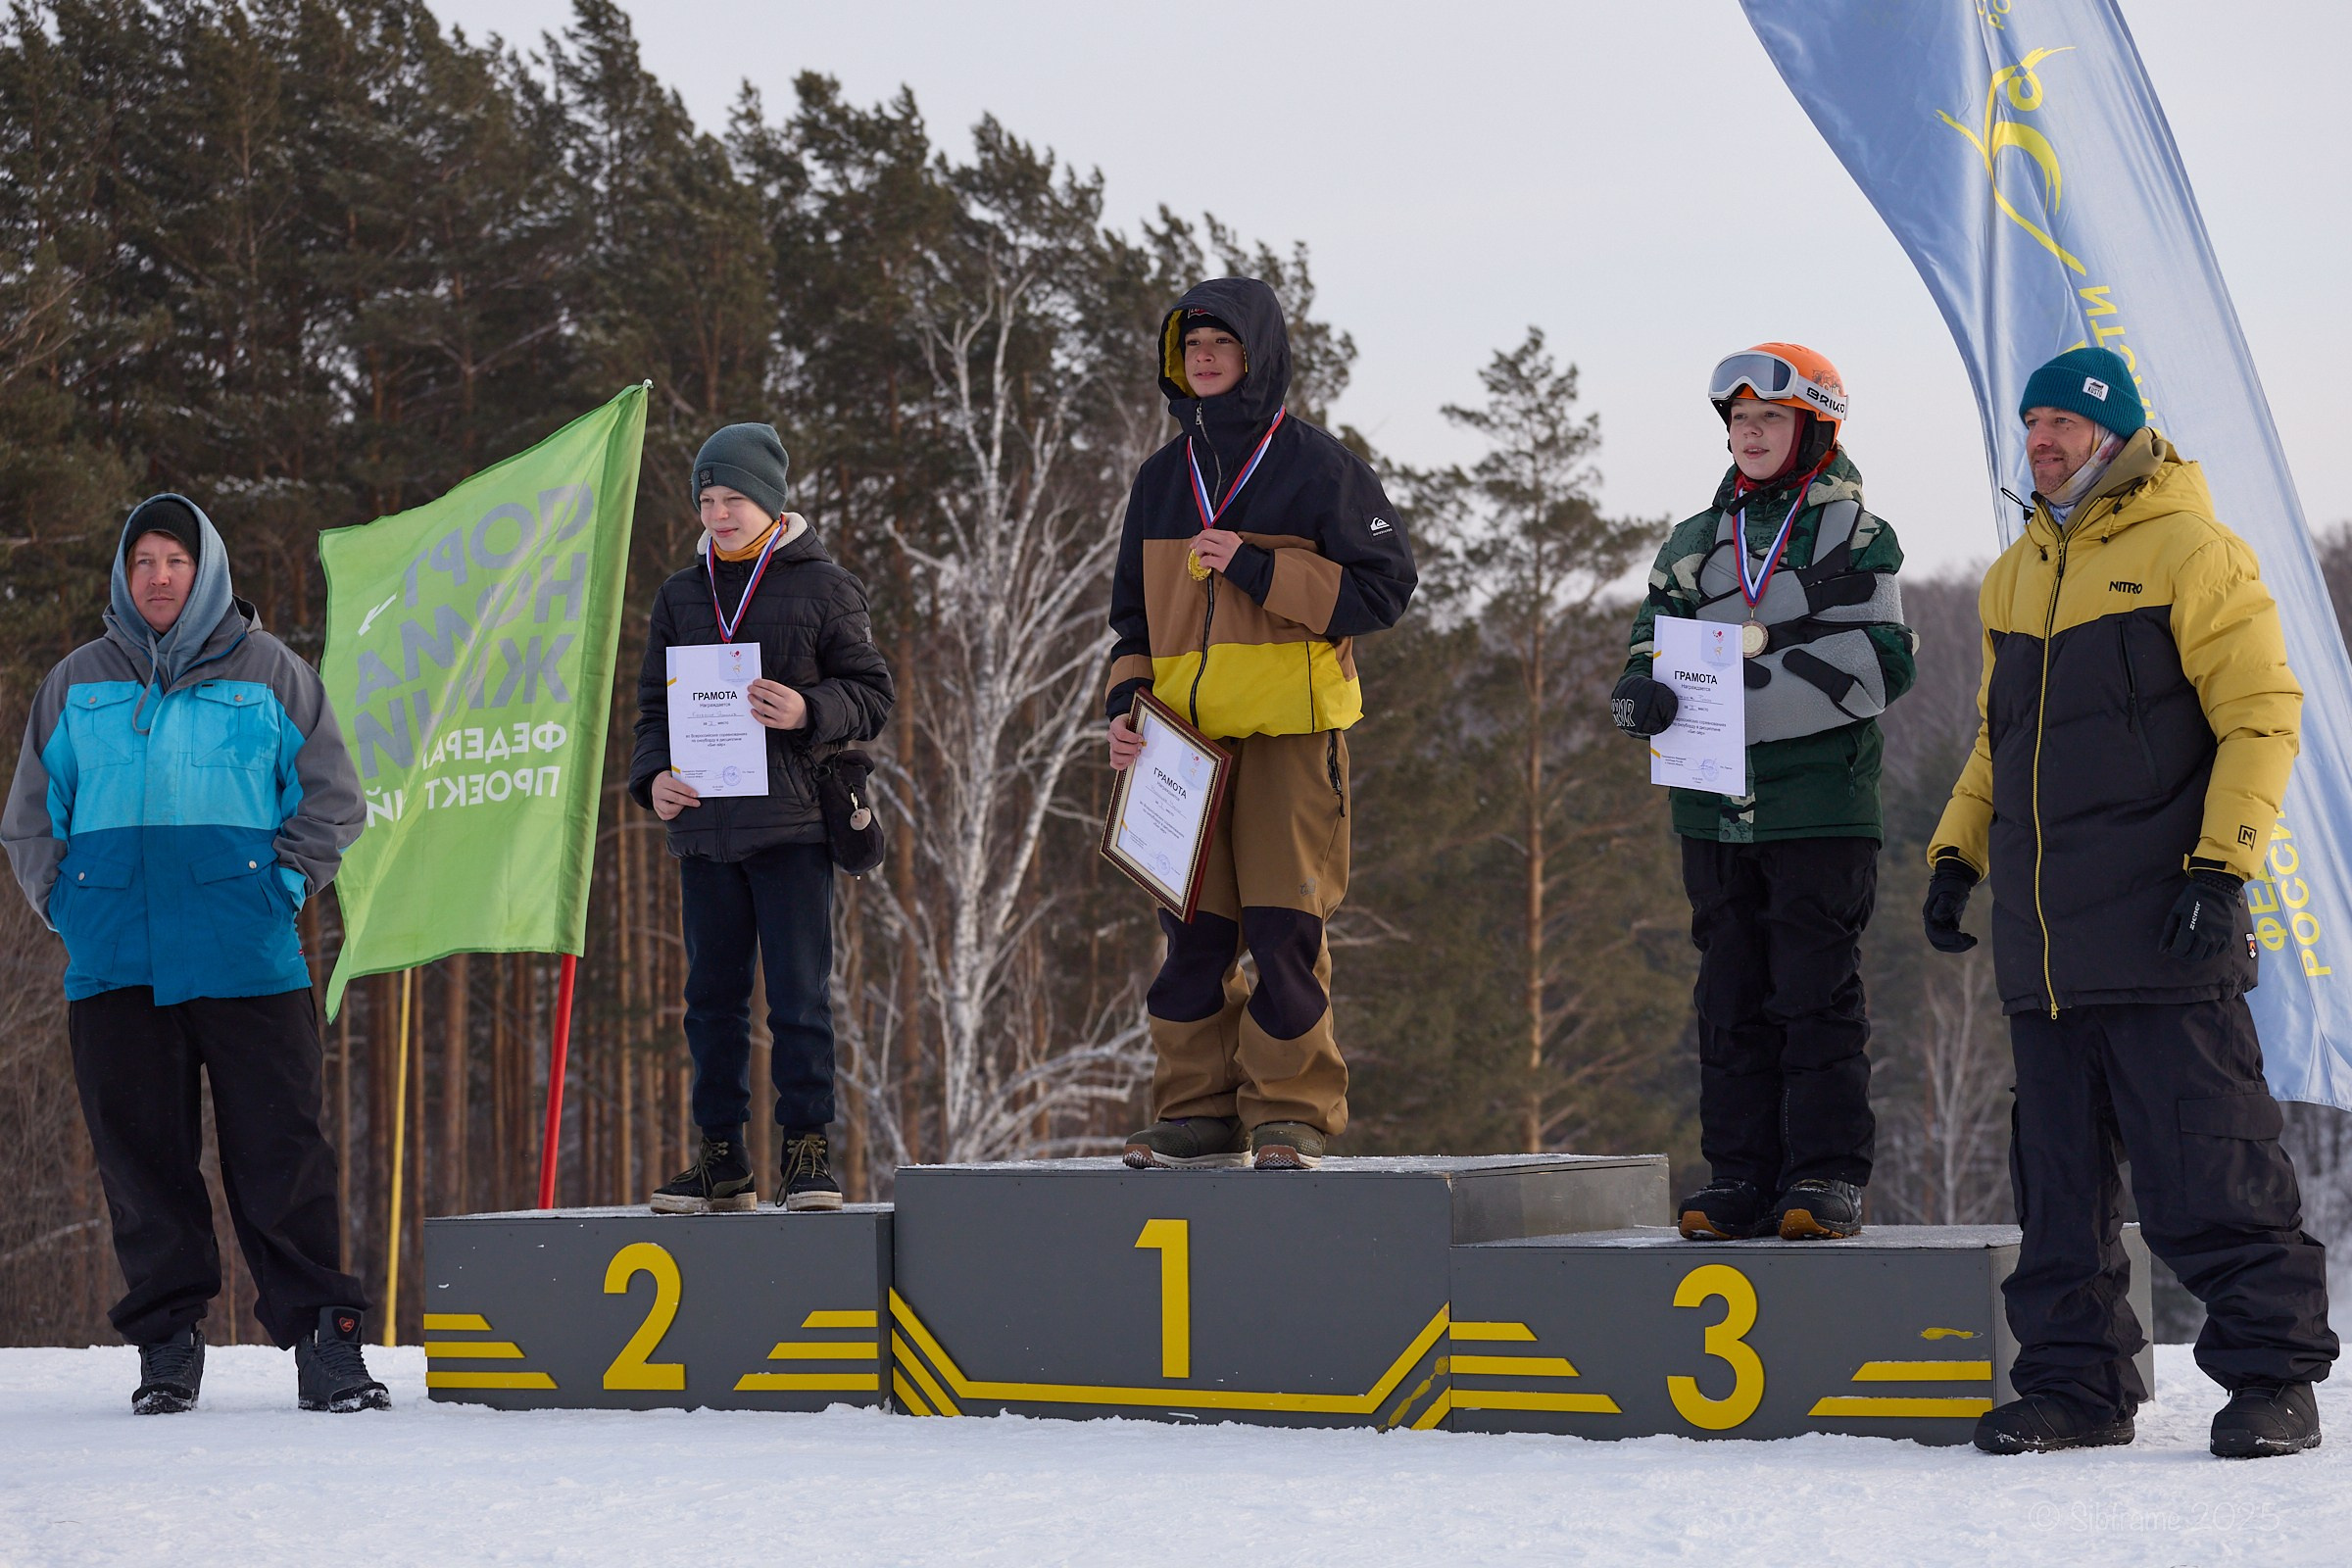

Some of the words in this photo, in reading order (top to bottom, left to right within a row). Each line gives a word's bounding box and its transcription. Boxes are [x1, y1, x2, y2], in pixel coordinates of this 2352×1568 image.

[1806, 386, 1845, 414] BRIKO
[2109, 580, 2143, 594] NITRO
[1674, 670, 1718, 685] ГРАМОТА
[692, 691, 738, 701] ГРАМОТА
[1153, 766, 1187, 800] ГРАМОТА
[2189, 901, 2201, 931] ziener
[1134, 1218, 1190, 1378] 1
[603, 1241, 686, 1392] 2
[1666, 1263, 1765, 1431] 3
